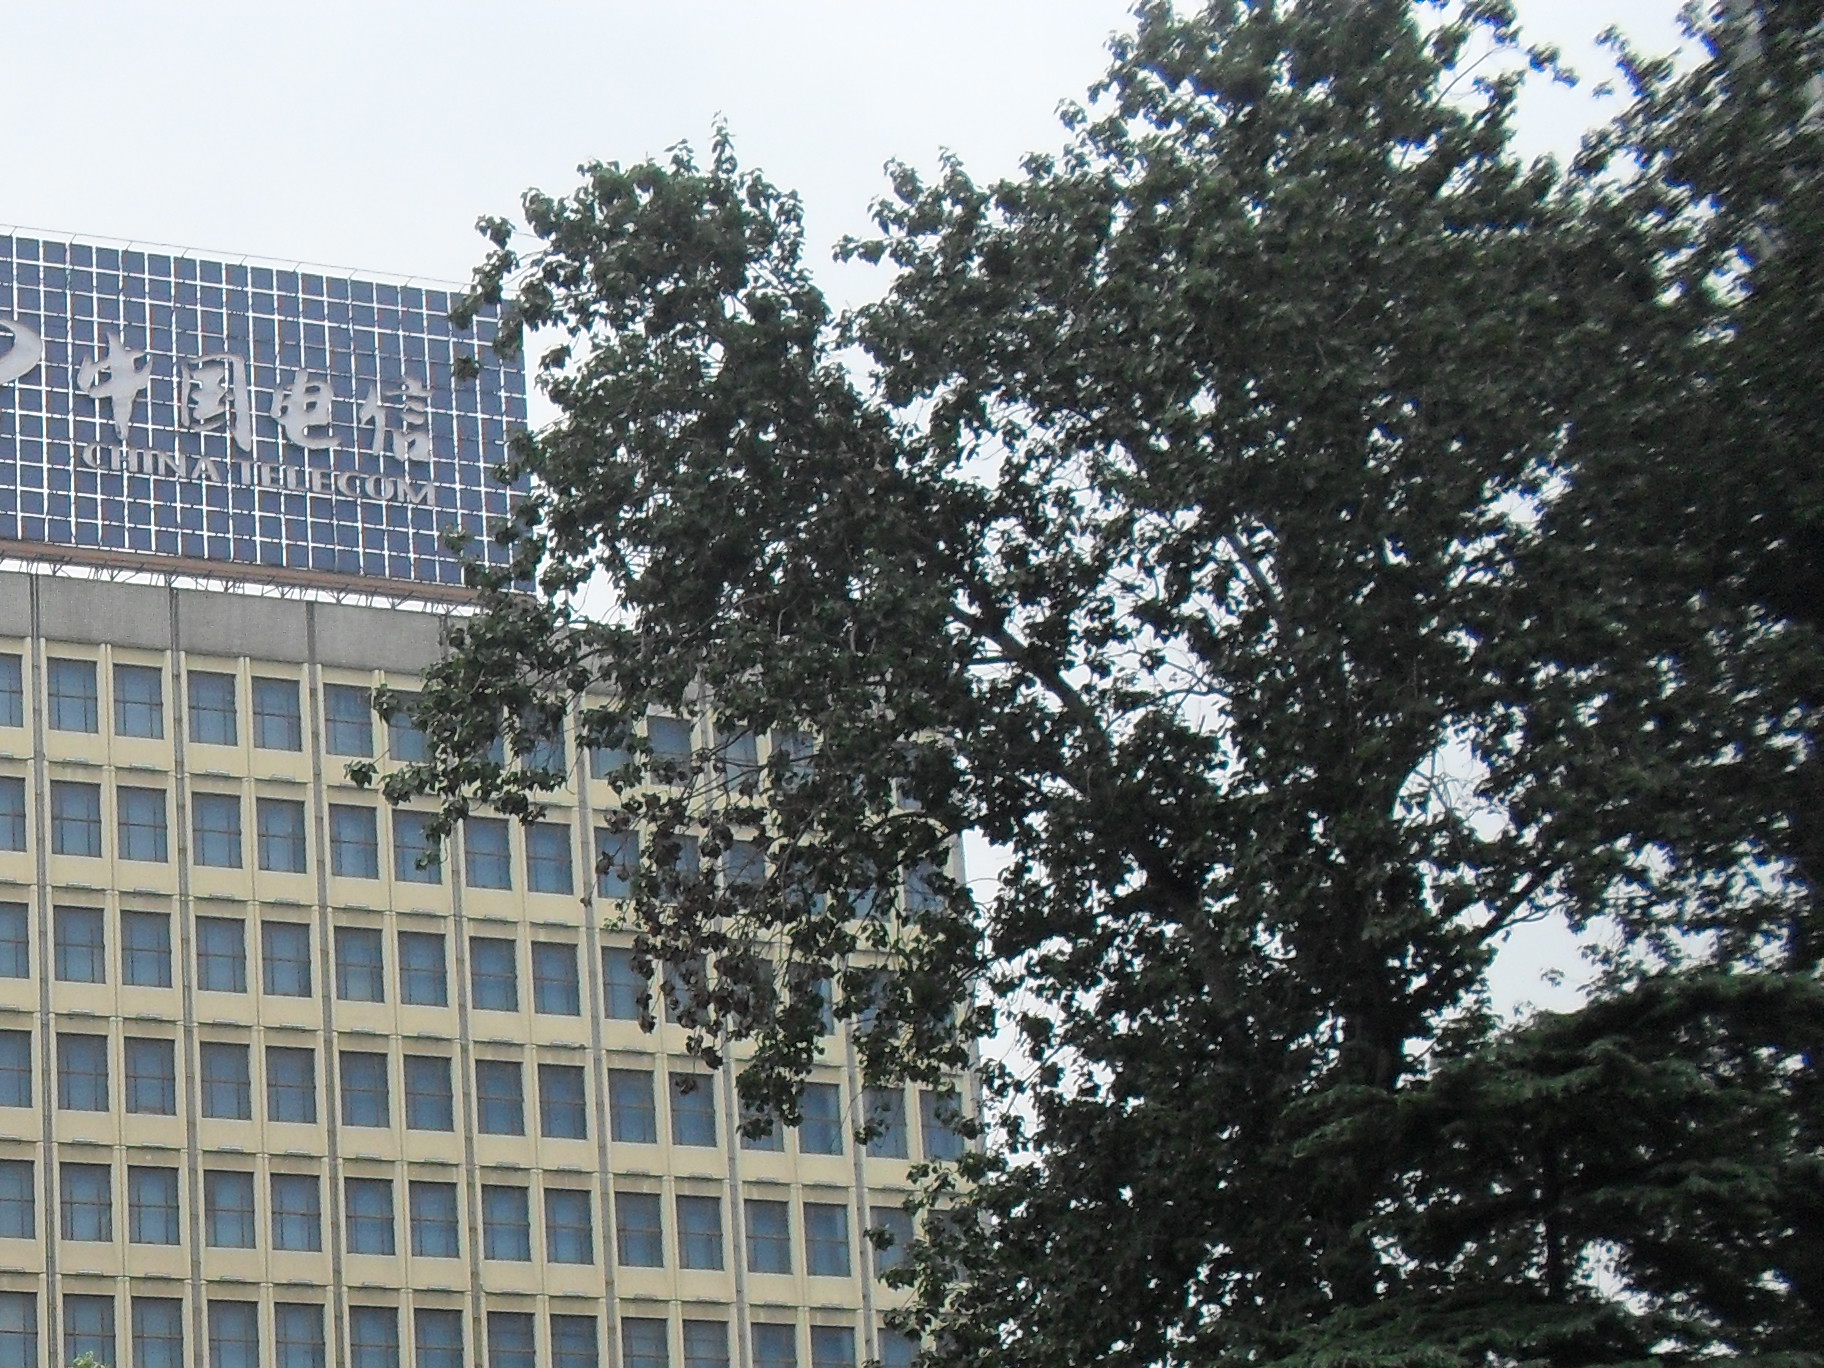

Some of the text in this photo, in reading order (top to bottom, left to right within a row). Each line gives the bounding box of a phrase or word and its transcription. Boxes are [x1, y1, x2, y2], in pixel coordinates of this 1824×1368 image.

[75, 330, 435, 463] 中国电信
[82, 441, 436, 509] CHINA TELECOM
